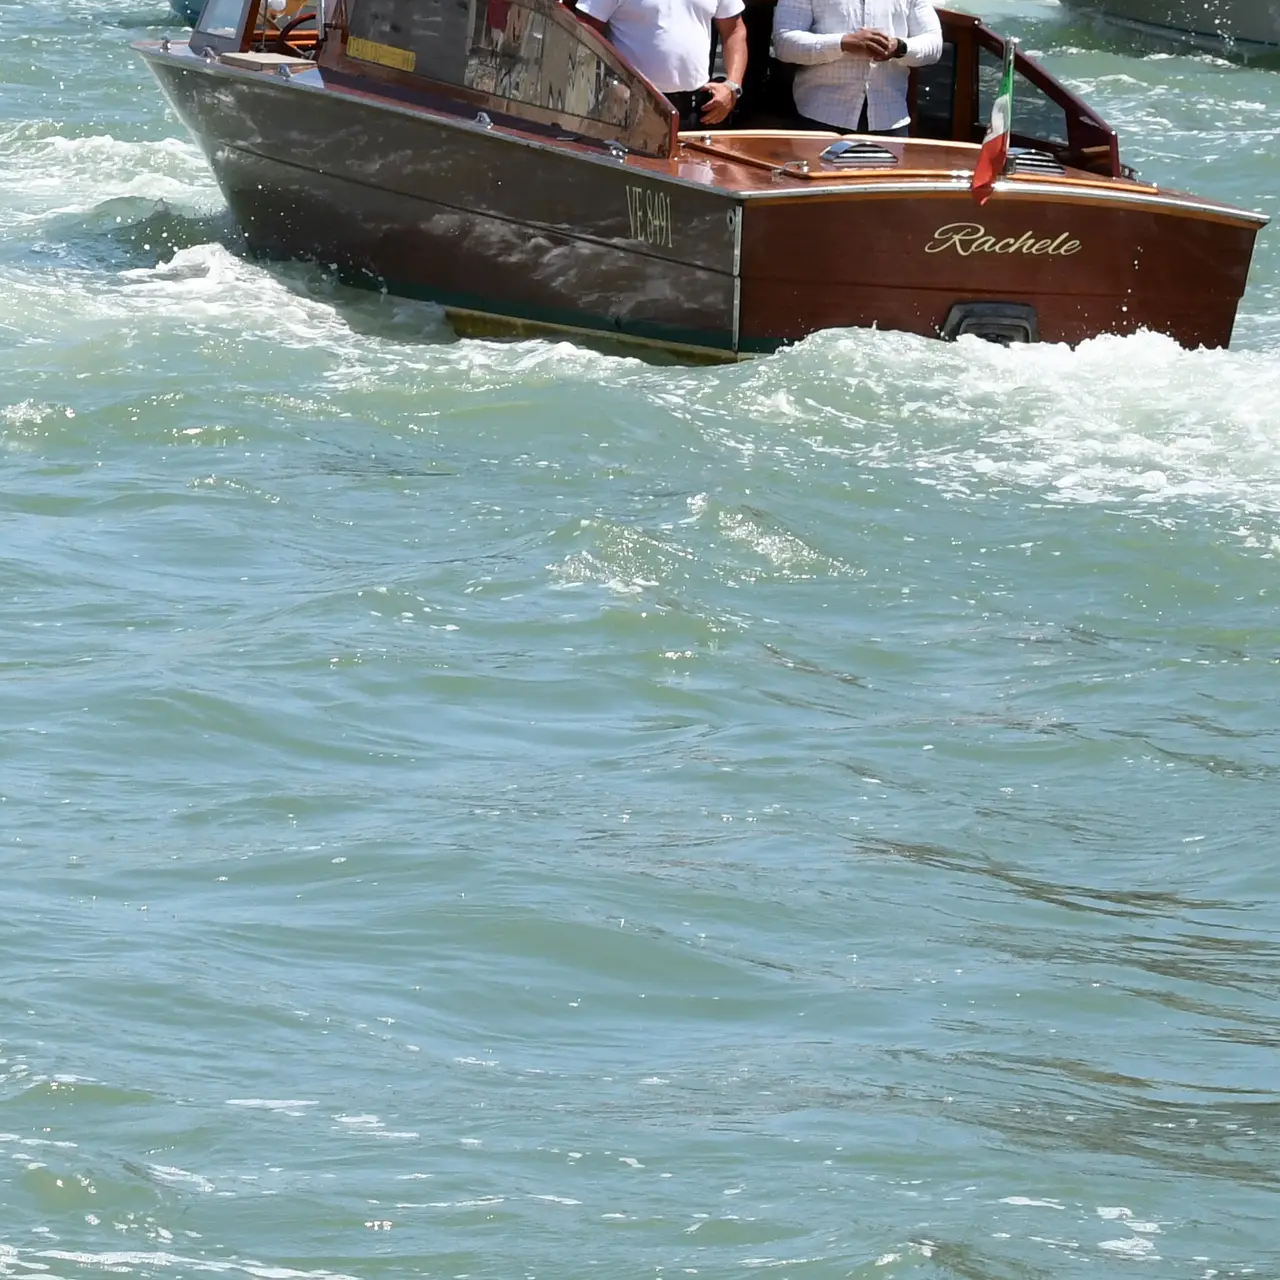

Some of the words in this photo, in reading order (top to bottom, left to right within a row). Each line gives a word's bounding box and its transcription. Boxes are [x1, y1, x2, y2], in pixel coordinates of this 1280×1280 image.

[624, 185, 646, 241] VE
[645, 189, 673, 248] 8491
[924, 222, 1082, 256] Rachele
